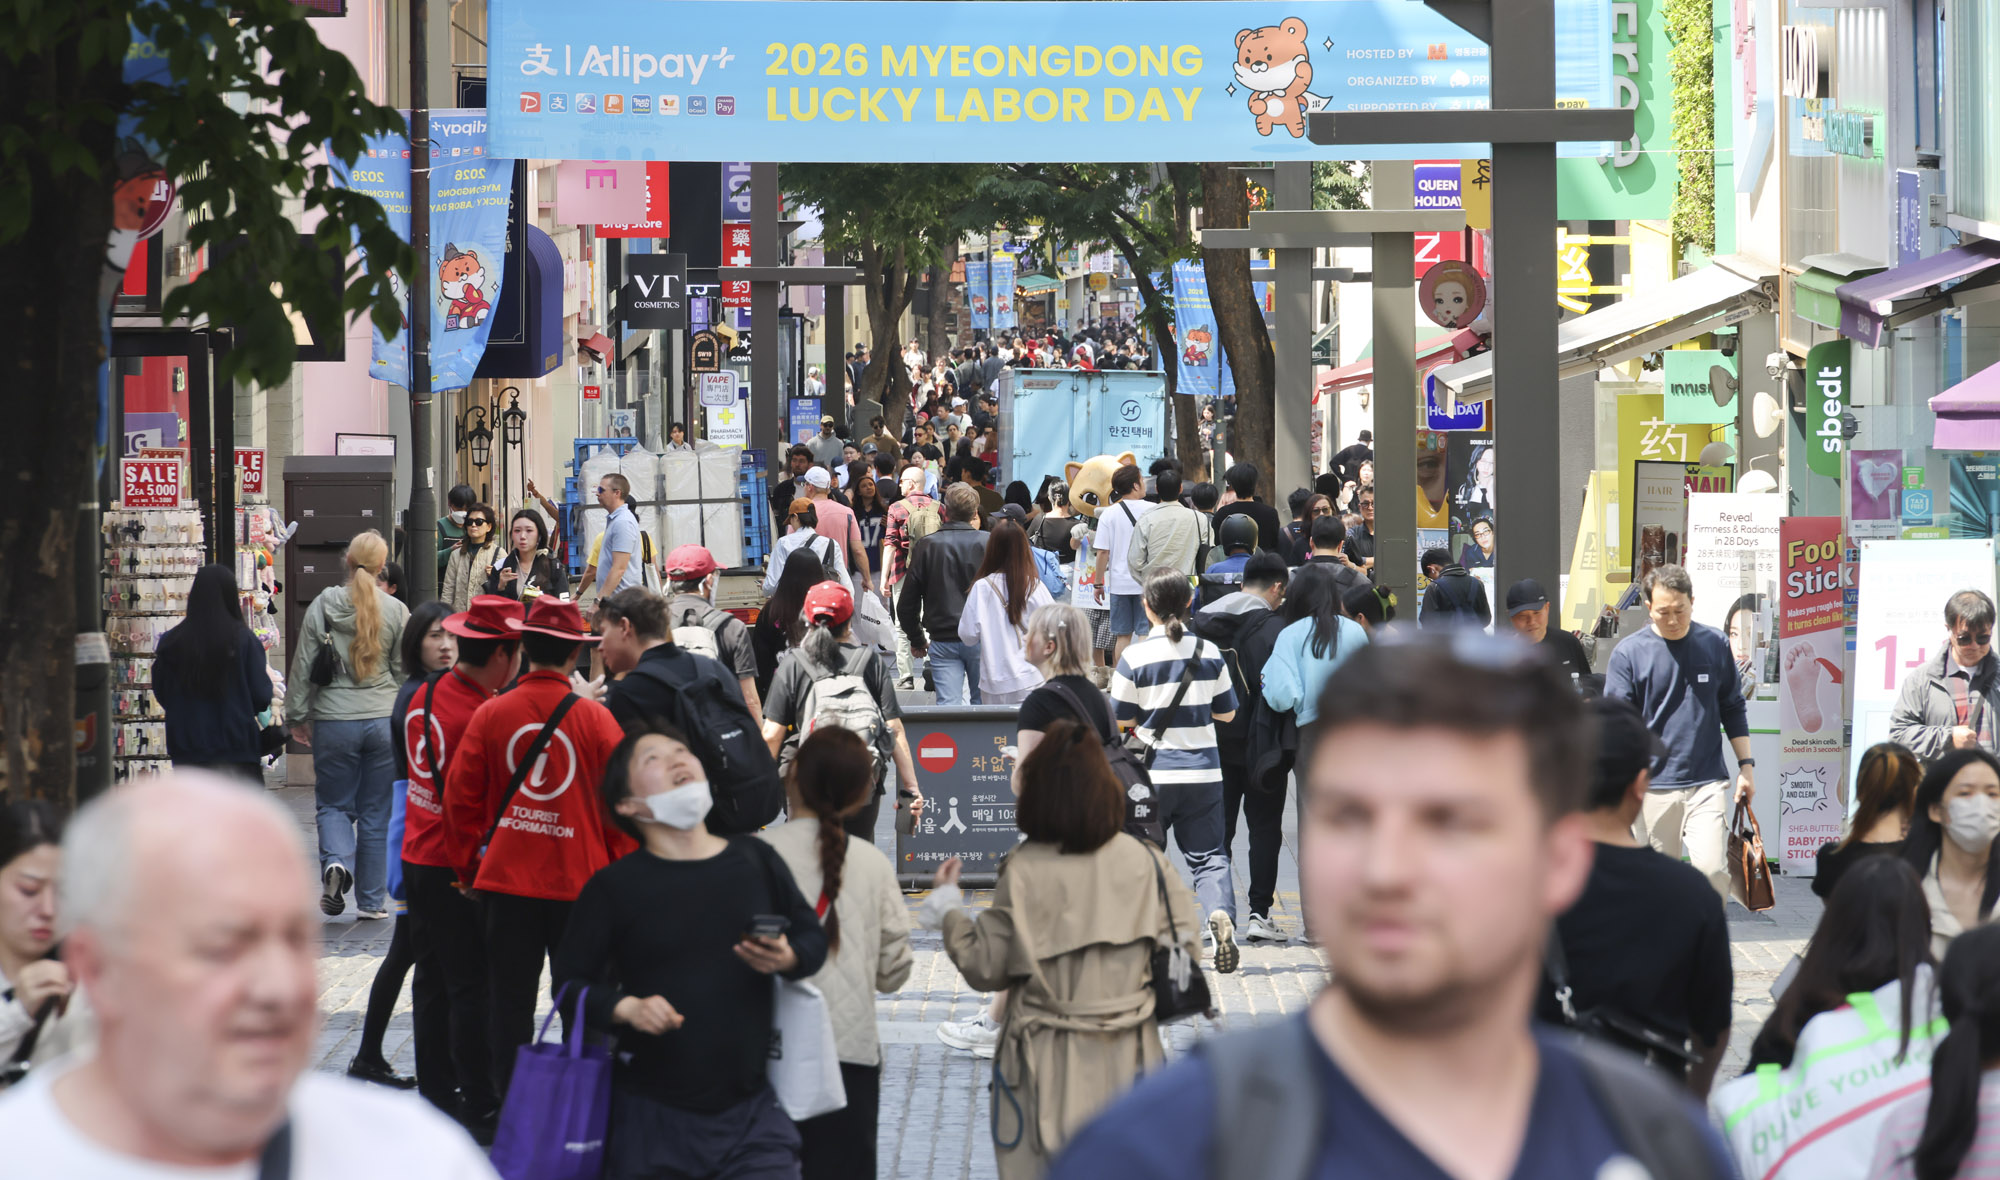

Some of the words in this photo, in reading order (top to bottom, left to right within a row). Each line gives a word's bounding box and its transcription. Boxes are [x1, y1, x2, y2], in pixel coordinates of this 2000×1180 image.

[765, 42, 868, 76] 2026
[881, 44, 1202, 77] MYEONGDONG
[1346, 49, 1395, 60] HOSTED
[1398, 49, 1414, 59] BY
[520, 43, 558, 76] 支
[578, 44, 736, 85] Alipay+
[1348, 76, 1418, 87] ORGANIZED
[1421, 75, 1437, 86] BY
[717, 103, 733, 113] Pay
[767, 86, 922, 122] LUCKY
[935, 87, 1090, 122] LABOR
[1104, 87, 1203, 122] DAY
[1347, 102, 1419, 111] SUPPORTED
[1422, 101, 1437, 110] BY
[1418, 179, 1458, 191] QUEEN
[634, 274, 680, 298] VT
[634, 301, 680, 309] COSMETICS
[721, 296, 739, 304] Drug
[706, 375, 729, 385] VAPE
[1816, 366, 1842, 453] sbedt
[1109, 425, 1153, 438] 한진택배
[125, 466, 177, 483] SALE
[127, 484, 145, 496] 2EA
[1647, 486, 1673, 496] HAIR
[1719, 512, 1753, 522] Reveal
[1693, 525, 1731, 534] Firmness
[1733, 525, 1739, 534] &
[1741, 525, 1780, 534] Radiance
[1714, 537, 1723, 546] in
[1724, 537, 1735, 546] 28
[1736, 537, 1759, 547] Days
[1787, 563, 1855, 599] Stick
[1787, 607, 1806, 618] Makes
[1806, 606, 1816, 616] you
[1817, 603, 1833, 614] rough
[1794, 618, 1812, 630] turns
[1813, 615, 1831, 626] clean
[1790, 781, 1813, 789] SMOOTH
[972, 794, 997, 802] 운영시간
[512, 806, 560, 824] TOURIST
[972, 808, 994, 822] 매일
[498, 817, 575, 838] NFORMATION
[1788, 825, 1810, 833] SHEA
[1788, 836, 1816, 846] BABY
[916, 852, 952, 861] 서울특별시
[1752, 1088, 1821, 1155] OLIVE
